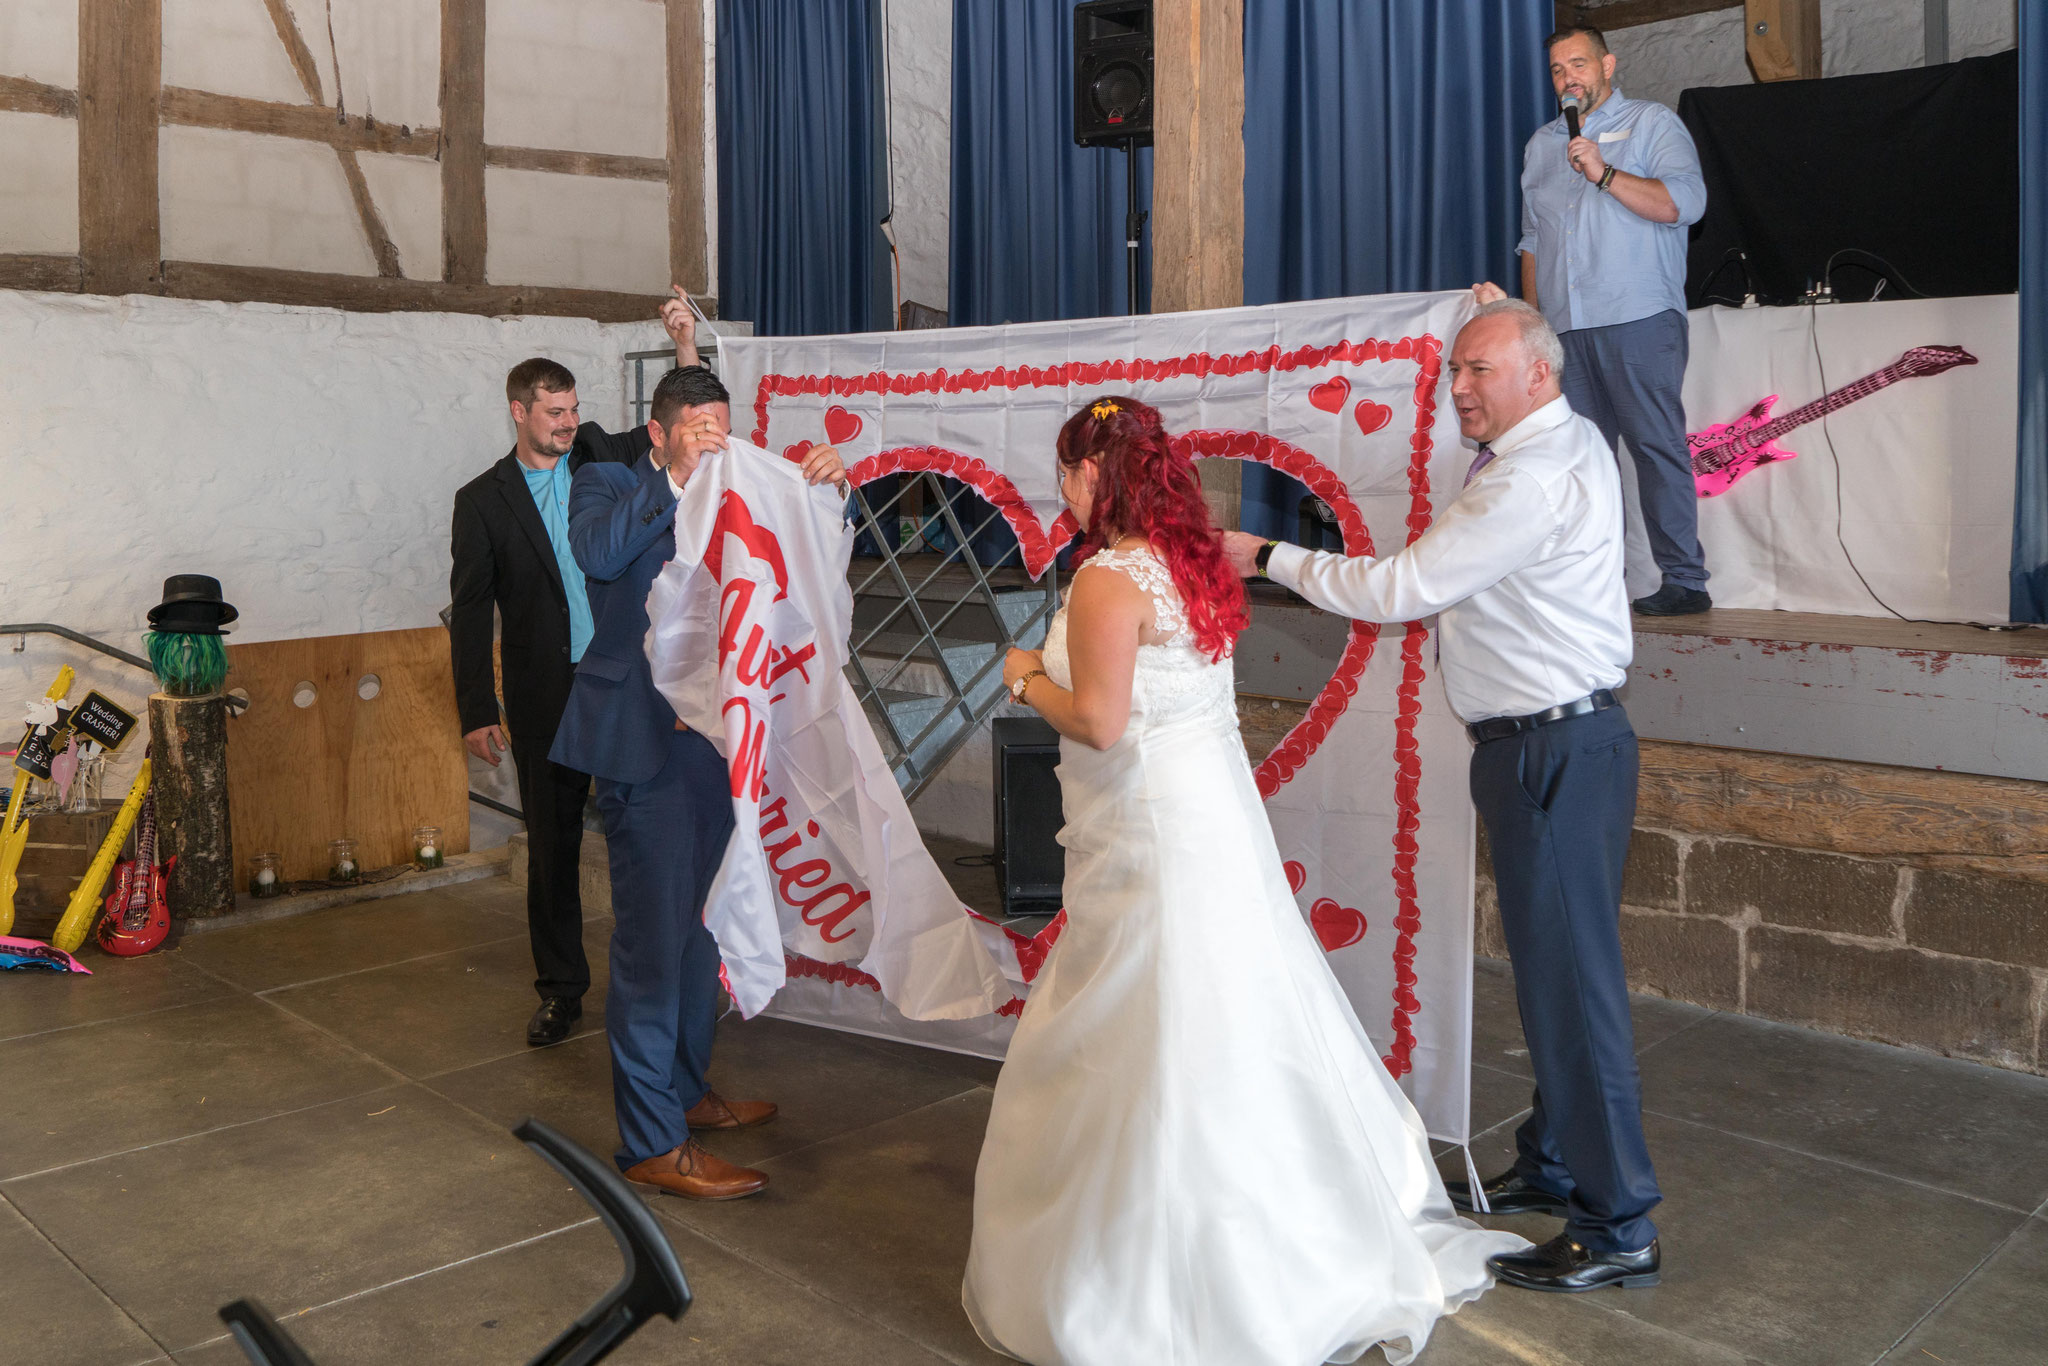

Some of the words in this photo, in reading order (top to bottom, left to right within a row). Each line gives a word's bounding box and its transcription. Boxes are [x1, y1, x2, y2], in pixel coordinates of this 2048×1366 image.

[80, 711, 120, 741] CRASHER!
[90, 701, 124, 730] Wedding
[22, 742, 38, 760] I'm
[31, 750, 44, 764] for
